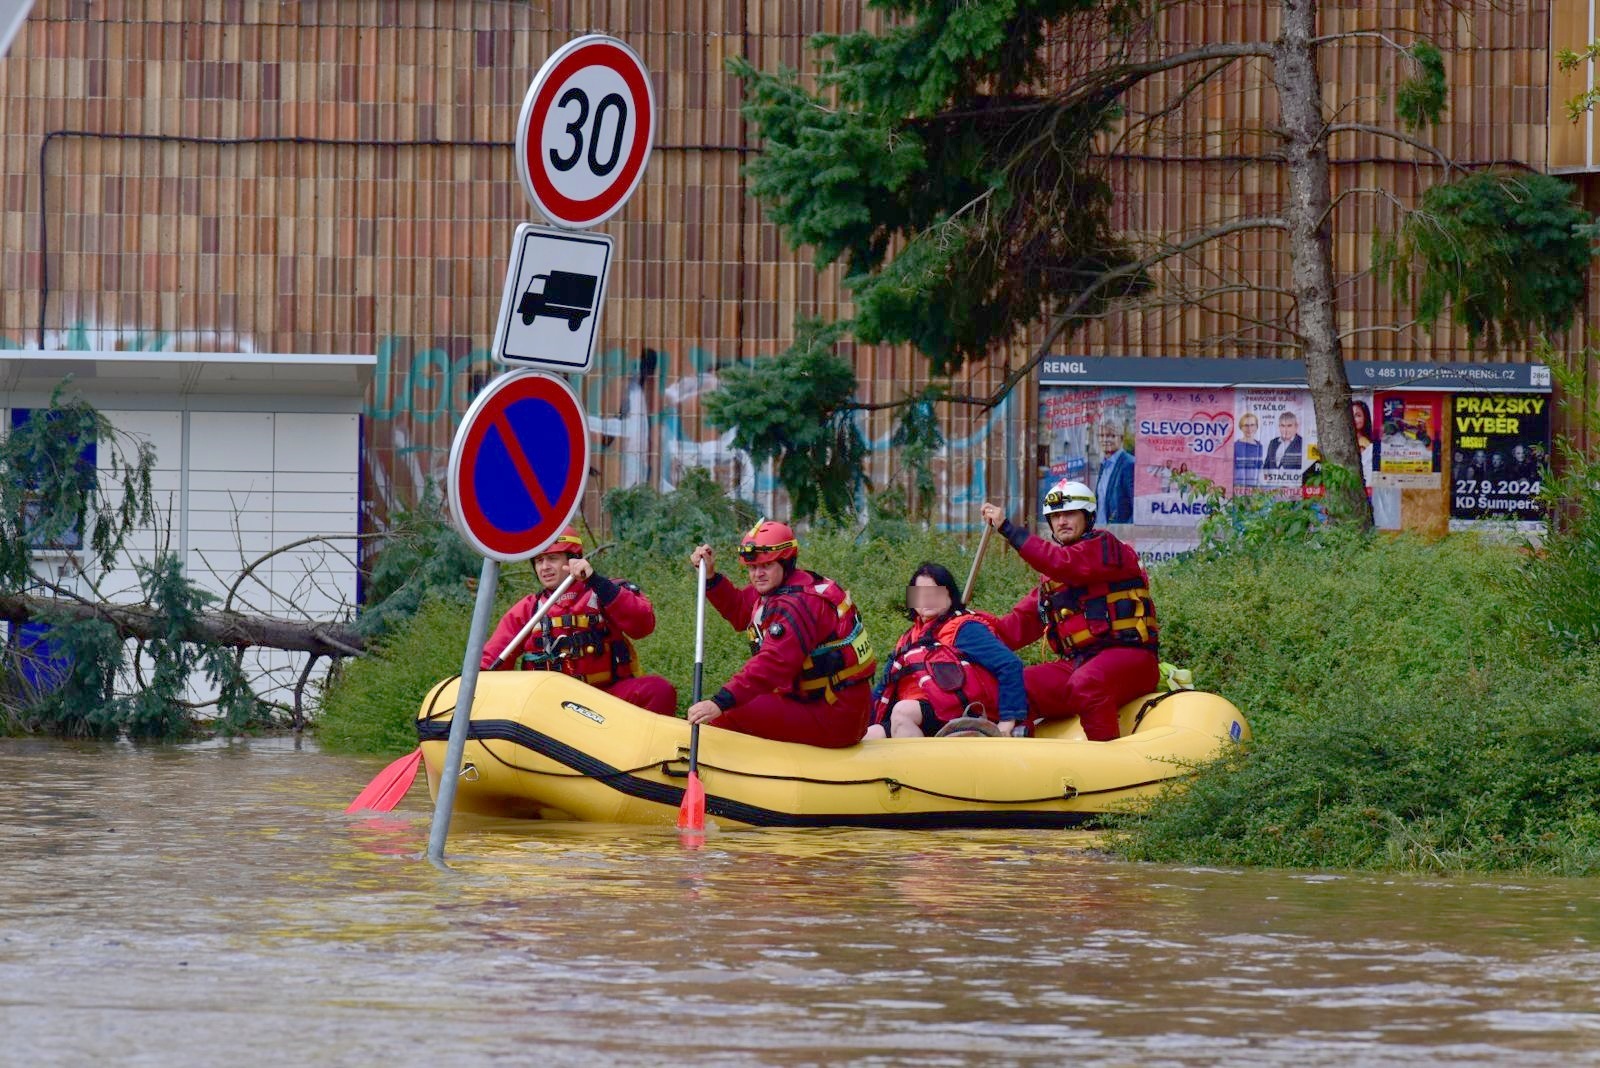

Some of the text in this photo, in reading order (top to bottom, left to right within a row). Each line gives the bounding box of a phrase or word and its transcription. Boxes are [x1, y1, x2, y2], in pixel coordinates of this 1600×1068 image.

[550, 88, 627, 176] 30
[1043, 361, 1087, 373] RENGL
[1378, 368, 1396, 378] 485
[1399, 368, 1415, 378] 110
[1141, 421, 1229, 435] SLEVODNY
[1456, 413, 1519, 434] VÝBĚR
[1456, 480, 1540, 494] 27.9.2024
[1455, 497, 1475, 508] KD
